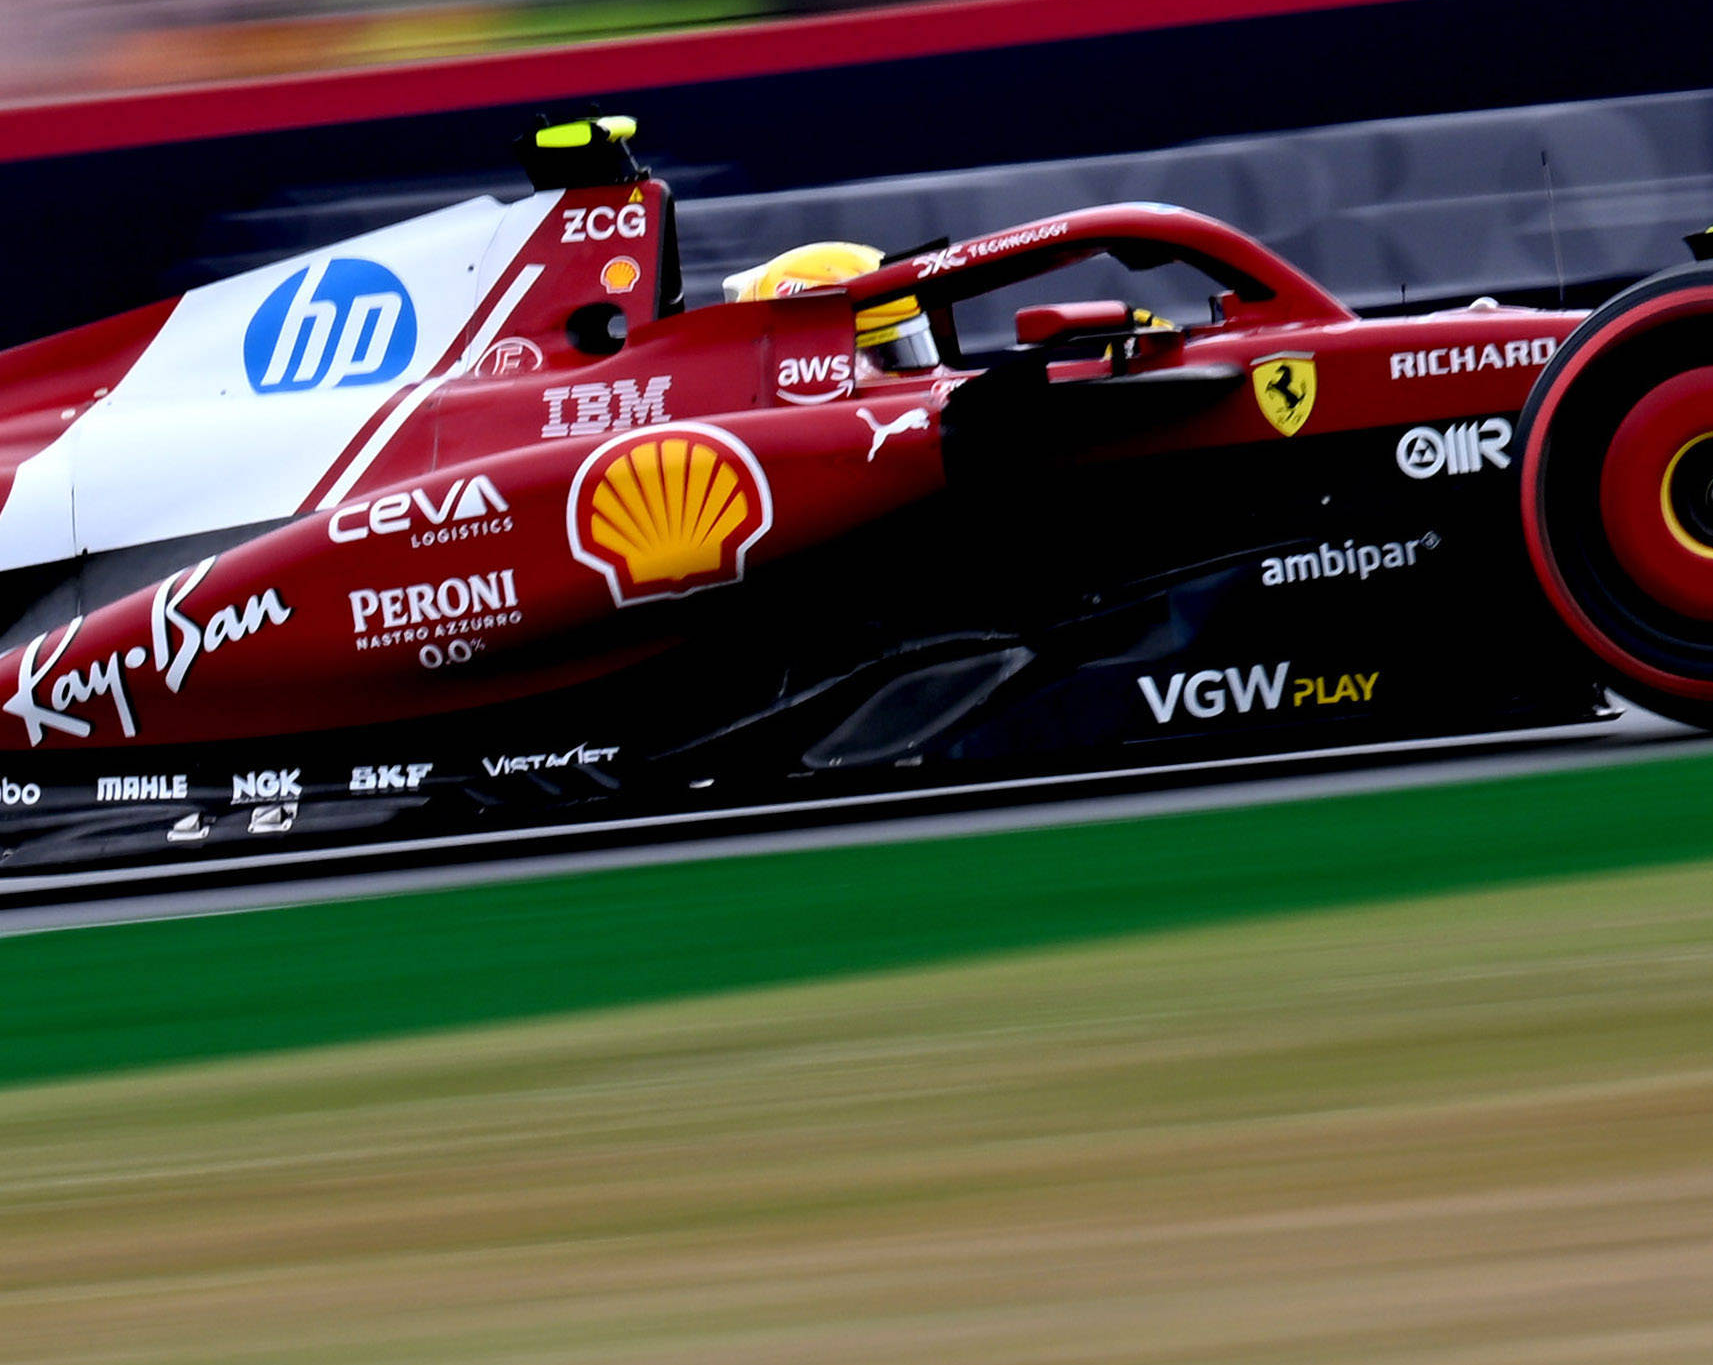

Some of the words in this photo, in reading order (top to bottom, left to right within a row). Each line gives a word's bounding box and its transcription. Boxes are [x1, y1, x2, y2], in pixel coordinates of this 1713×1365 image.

[561, 204, 646, 243] ZCG
[967, 221, 1069, 258] TECHNOLOGY
[260, 256, 403, 388] hp
[778, 355, 851, 387] aws
[1390, 337, 1557, 380] RICHARD
[541, 375, 673, 438] IBM
[411, 516, 514, 549] LOGISTICS
[1261, 539, 1419, 586] ambipar
[348, 569, 519, 634] PERONI
[355, 626, 429, 651] NASTRO
[434, 610, 523, 638] AZZURRO
[1137, 661, 1291, 724] VGW
[1293, 671, 1380, 707] PLAY
[97, 775, 188, 801] MAHLE
[232, 767, 303, 798] NGK
